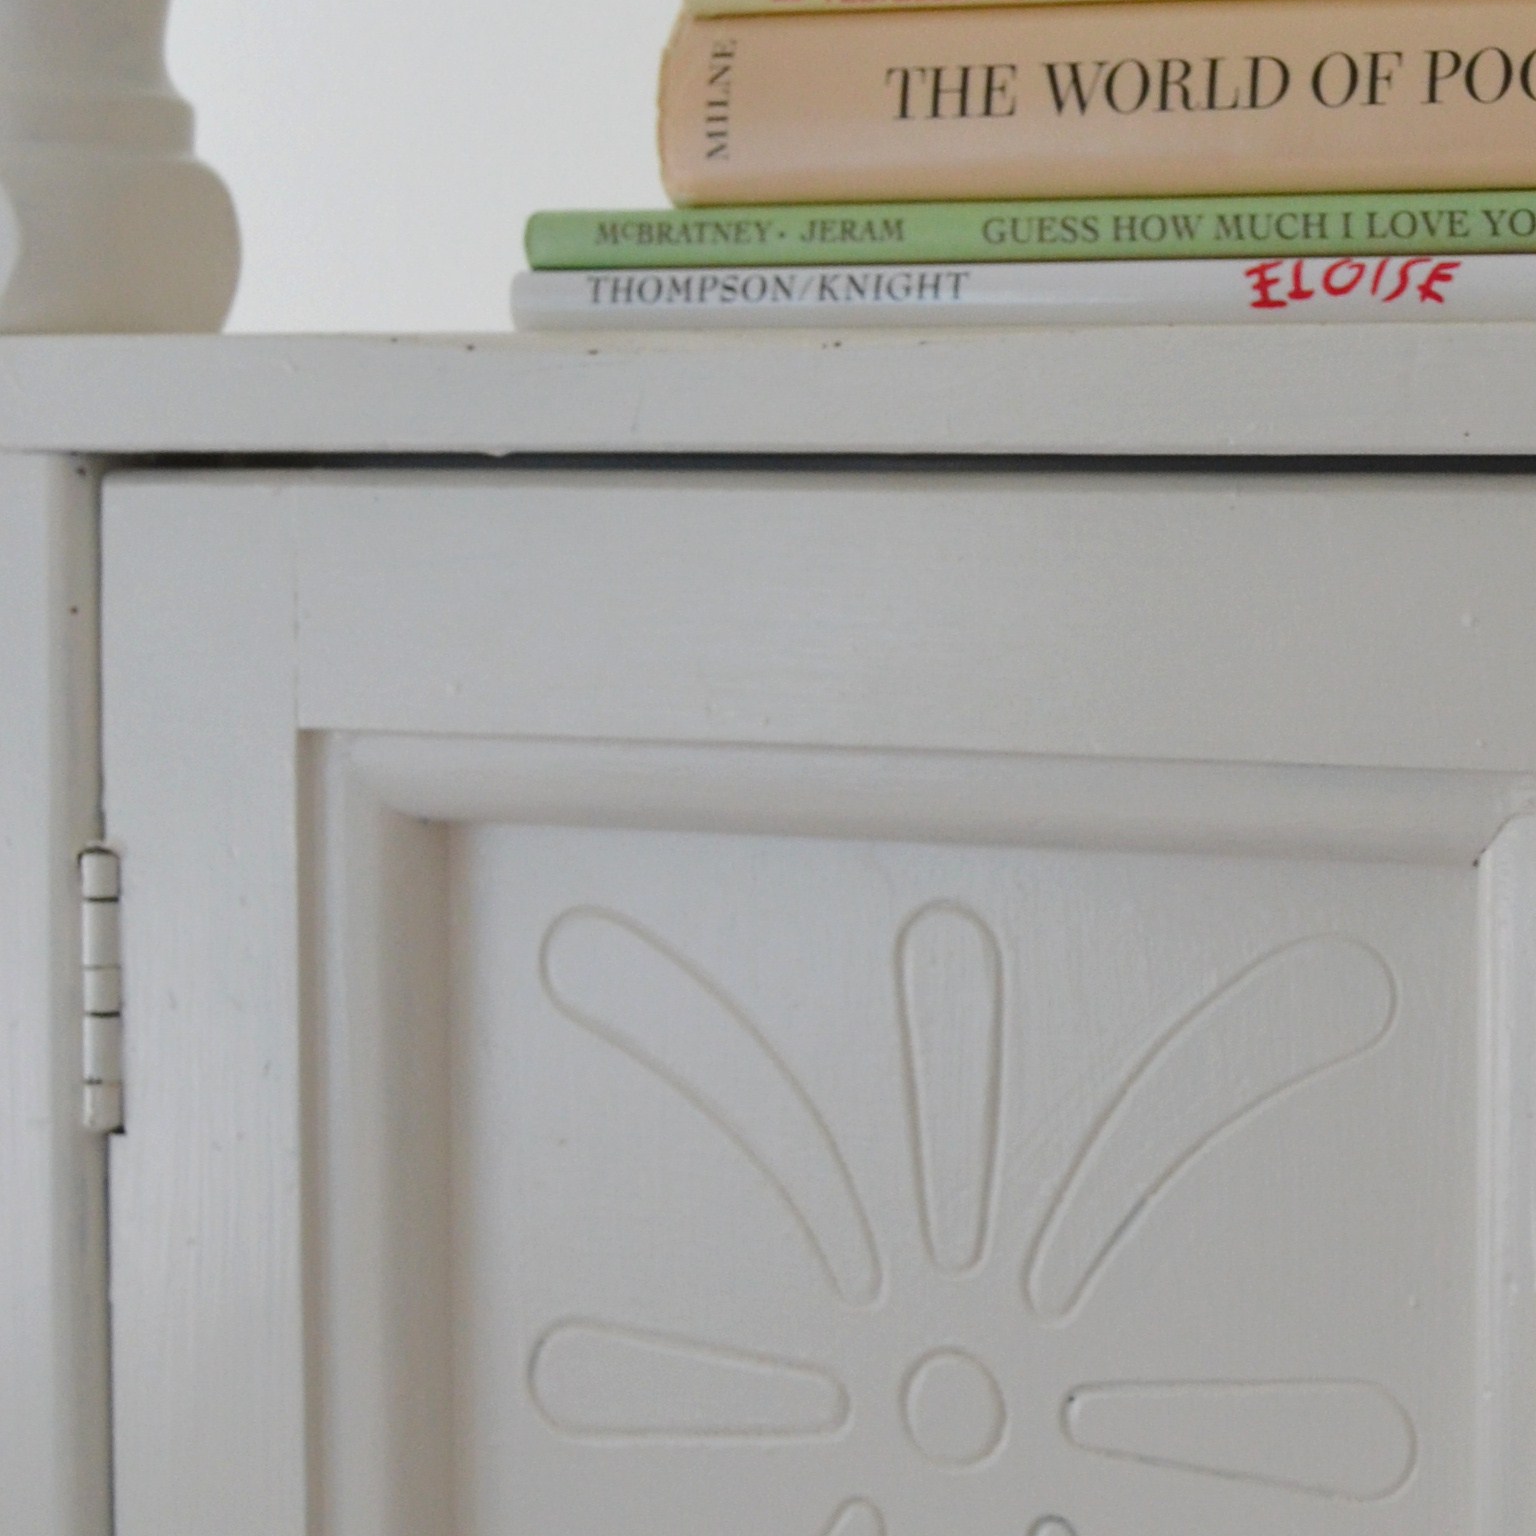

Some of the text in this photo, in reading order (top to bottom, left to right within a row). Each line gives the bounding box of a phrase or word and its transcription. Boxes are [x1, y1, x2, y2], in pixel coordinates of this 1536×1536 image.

[705, 39, 738, 161] MILNE
[885, 64, 1018, 120] THE
[1041, 55, 1291, 117] WORLD
[1311, 50, 1403, 108] OF
[800, 218, 905, 242] JERAM
[981, 216, 1101, 247] GUESS
[1112, 214, 1203, 242] HOW
[1212, 210, 1329, 241] MUCH
[1341, 211, 1353, 238] I
[1365, 209, 1469, 240] LOVE
[586, 271, 970, 305] THOMPSON/KNIGHT
[1244, 257, 1461, 309] ELOISE
